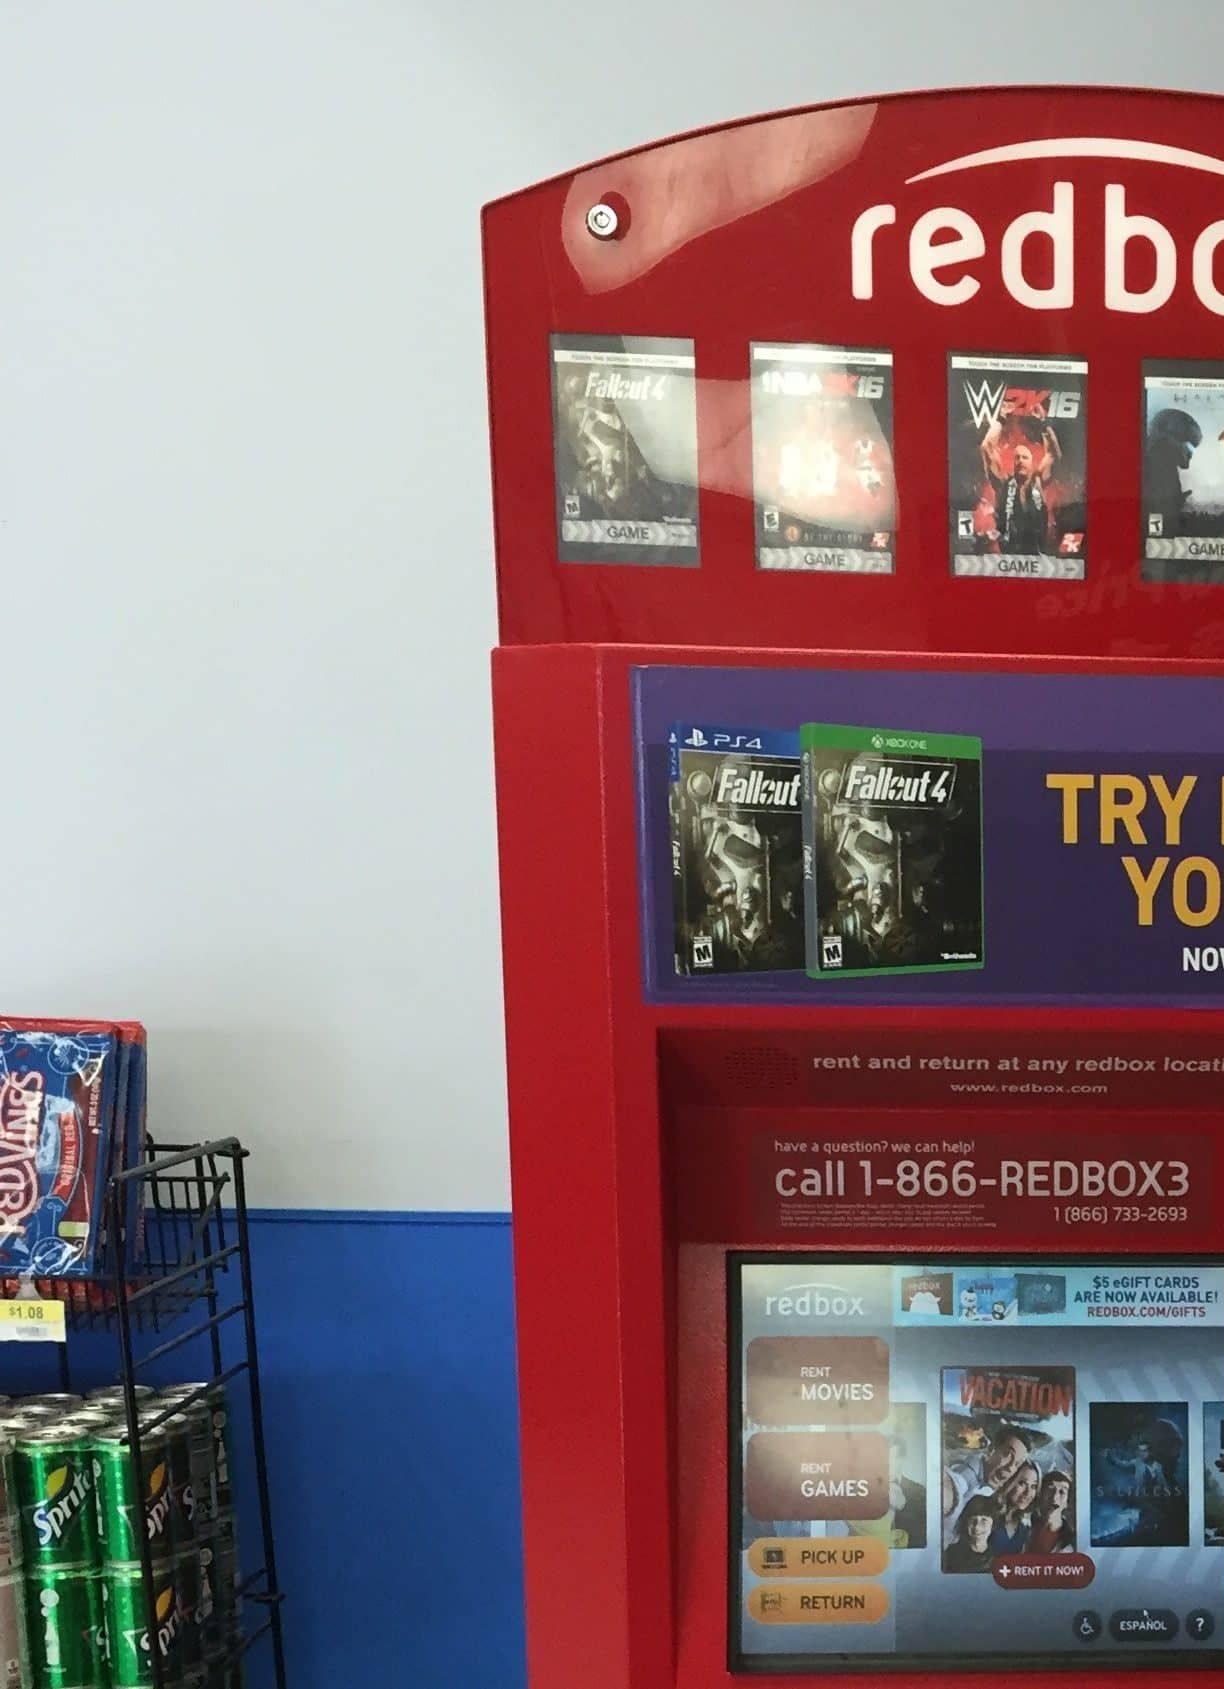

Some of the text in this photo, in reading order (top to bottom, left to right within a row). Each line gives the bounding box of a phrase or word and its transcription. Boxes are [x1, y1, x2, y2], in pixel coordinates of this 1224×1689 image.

[584, 372, 668, 401] Fallout 4
[607, 526, 650, 540] GAME
[804, 553, 846, 566] GAME
[998, 560, 1040, 574] GAME
[714, 734, 763, 749] PS4
[717, 768, 801, 806] Fallout
[844, 765, 931, 802] Fallout
[931, 770, 950, 803] 4
[1046, 773, 1197, 845] TRY
[813, 1053, 863, 1070] rent
[868, 1055, 912, 1071] and
[919, 1055, 990, 1072] return
[997, 1057, 1020, 1072] at
[1025, 1060, 1067, 1075] any
[1075, 1055, 1157, 1072] redbox
[950, 1082, 1108, 1094] www.redbox.com
[774, 1140, 975, 1155] have a question? we can help!
[775, 1158, 1190, 1199] call 1-866-REDBOX3
[1053, 1204, 1188, 1224] 1 (866) 733-2693
[1092, 1275, 1200, 1290] $5 eGIFT CARDS
[765, 1292, 864, 1316] redbox
[1074, 1290, 1219, 1304] ARE NOW AVAILABLE!
[9, 1307, 43, 1320] $1.08
[1087, 1306, 1206, 1318] REDBOX.COM/GIFTS
[800, 1367, 831, 1378] RENT
[800, 1383, 873, 1401] MOVIES
[959, 1375, 1072, 1417] VACATION
[800, 1463, 831, 1474] RENT
[800, 1480, 869, 1498] GAMES
[800, 1549, 864, 1565] PICK UP
[1014, 1565, 1085, 1577] RENT IT NOW!
[800, 1595, 865, 1610] RETURN
[1119, 1616, 1167, 1631] ESPAÑOL
